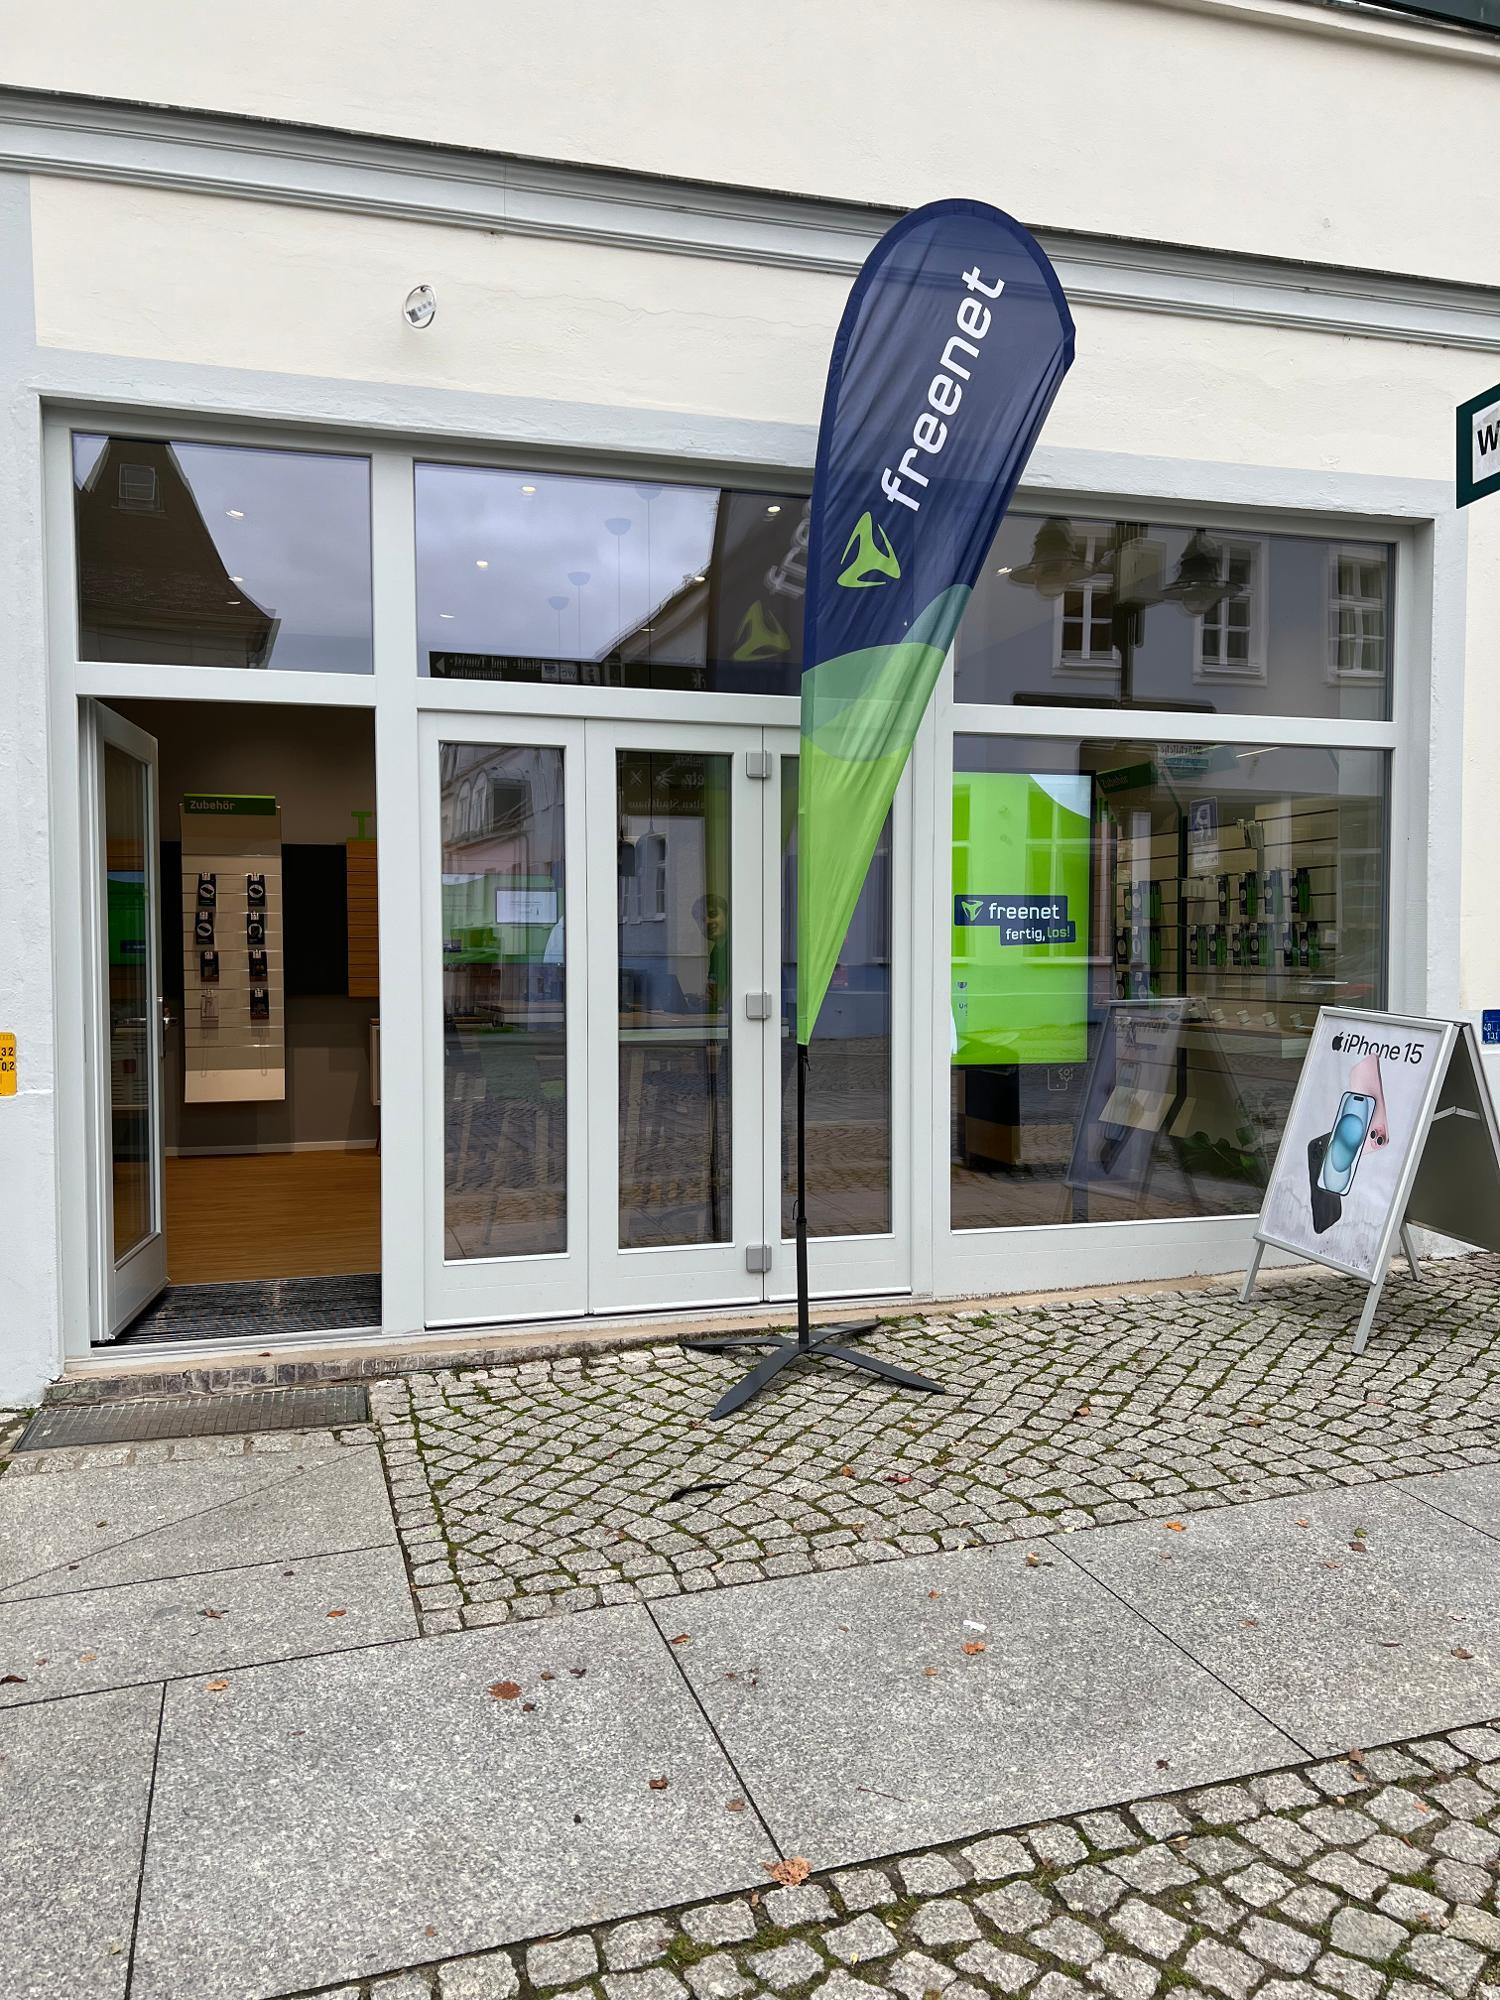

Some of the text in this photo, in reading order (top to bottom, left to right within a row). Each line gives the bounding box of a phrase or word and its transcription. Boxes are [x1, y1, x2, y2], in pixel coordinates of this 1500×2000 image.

[879, 265, 1006, 512] freenet
[189, 799, 236, 811] Zubehör
[988, 902, 1060, 920] freenet
[1005, 926, 1071, 942] fertig, los!
[1342, 1033, 1425, 1065] iPhone 15
